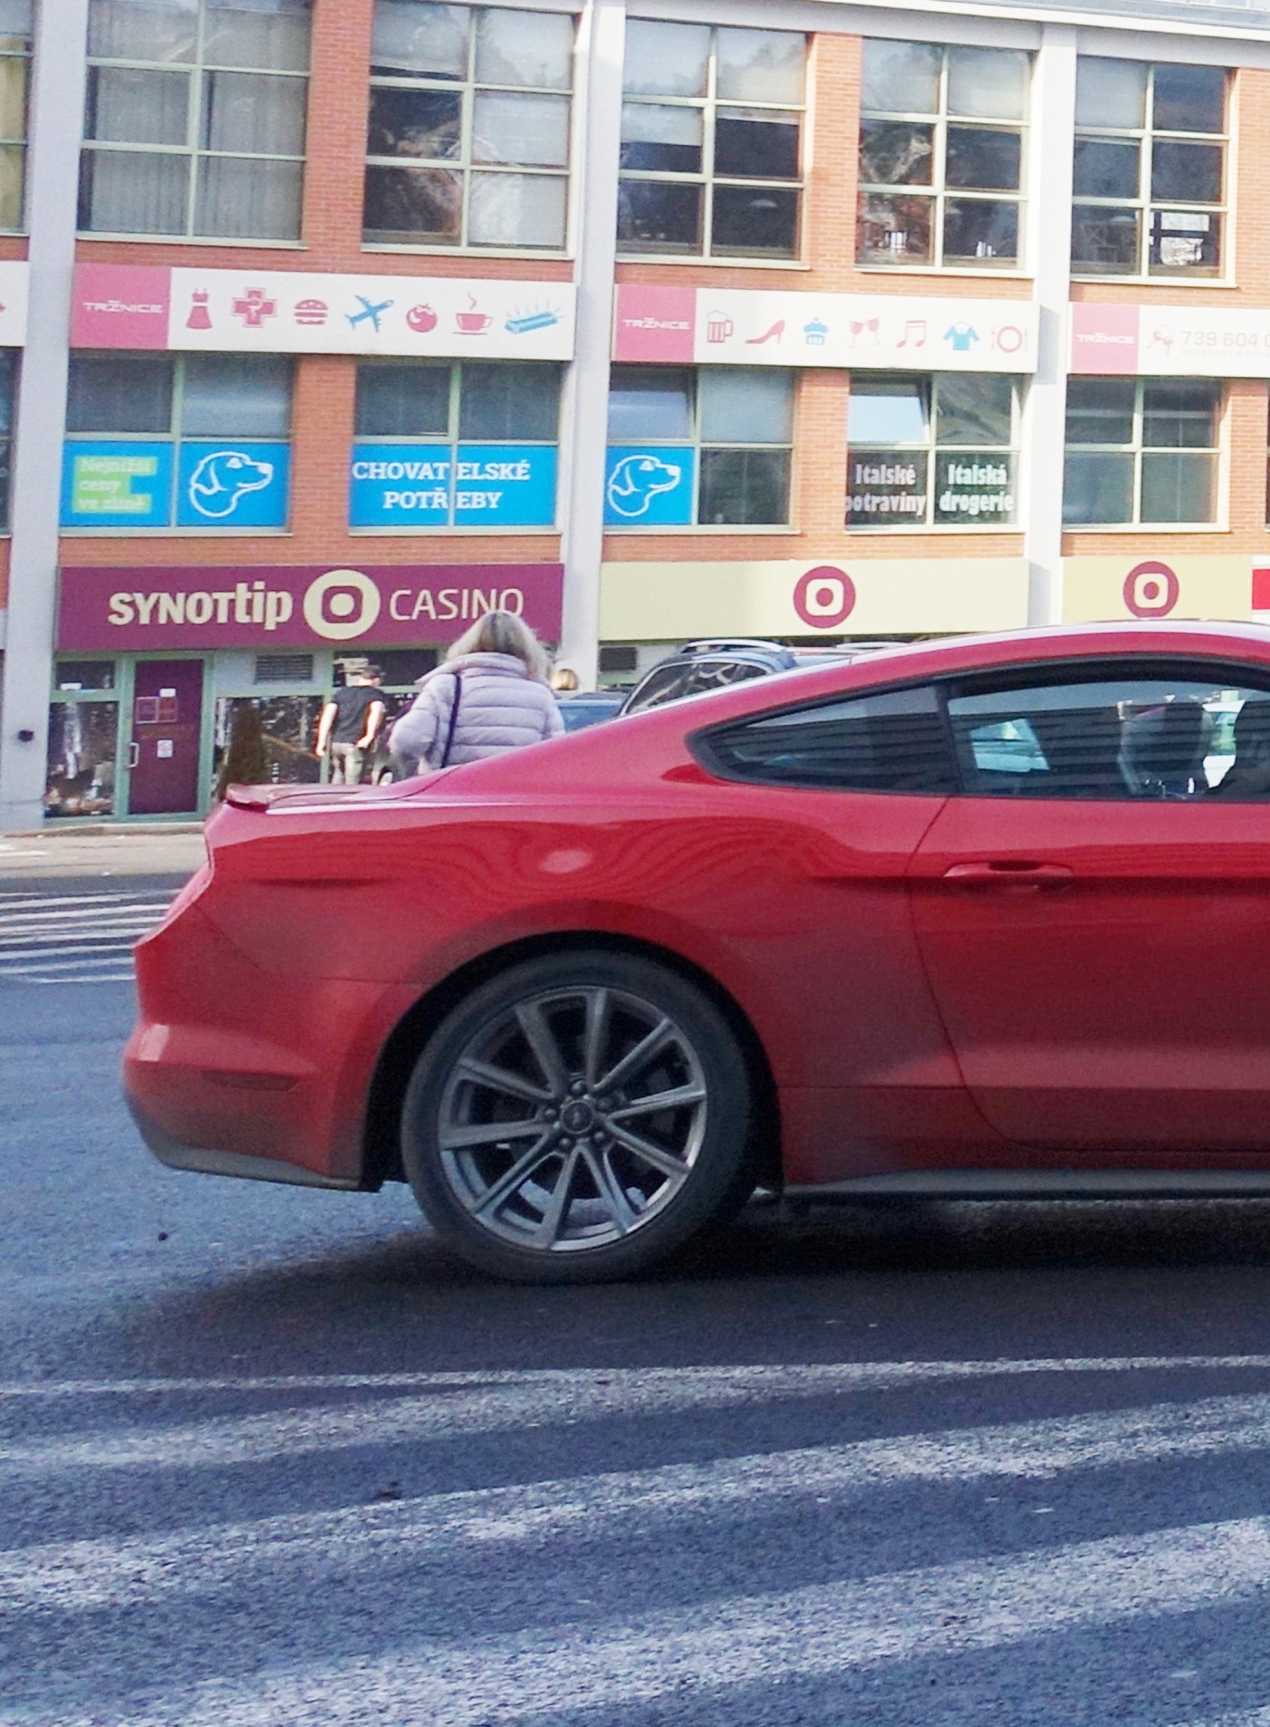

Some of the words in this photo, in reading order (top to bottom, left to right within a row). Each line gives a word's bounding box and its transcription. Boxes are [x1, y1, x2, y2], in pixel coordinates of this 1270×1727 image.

[83, 300, 164, 314] TRŽNICE
[622, 316, 690, 331] TRŽNICE
[1076, 331, 1135, 345] TRŽNICE
[1181, 330, 1217, 347] 739
[1223, 332, 1258, 348] 604
[855, 463, 917, 486] Italské
[948, 463, 1008, 486] Italská
[845, 491, 927, 517] potraviny
[939, 490, 1015, 516] drogerie
[107, 580, 293, 631] SYNOTtip
[389, 587, 524, 622] CASINO
